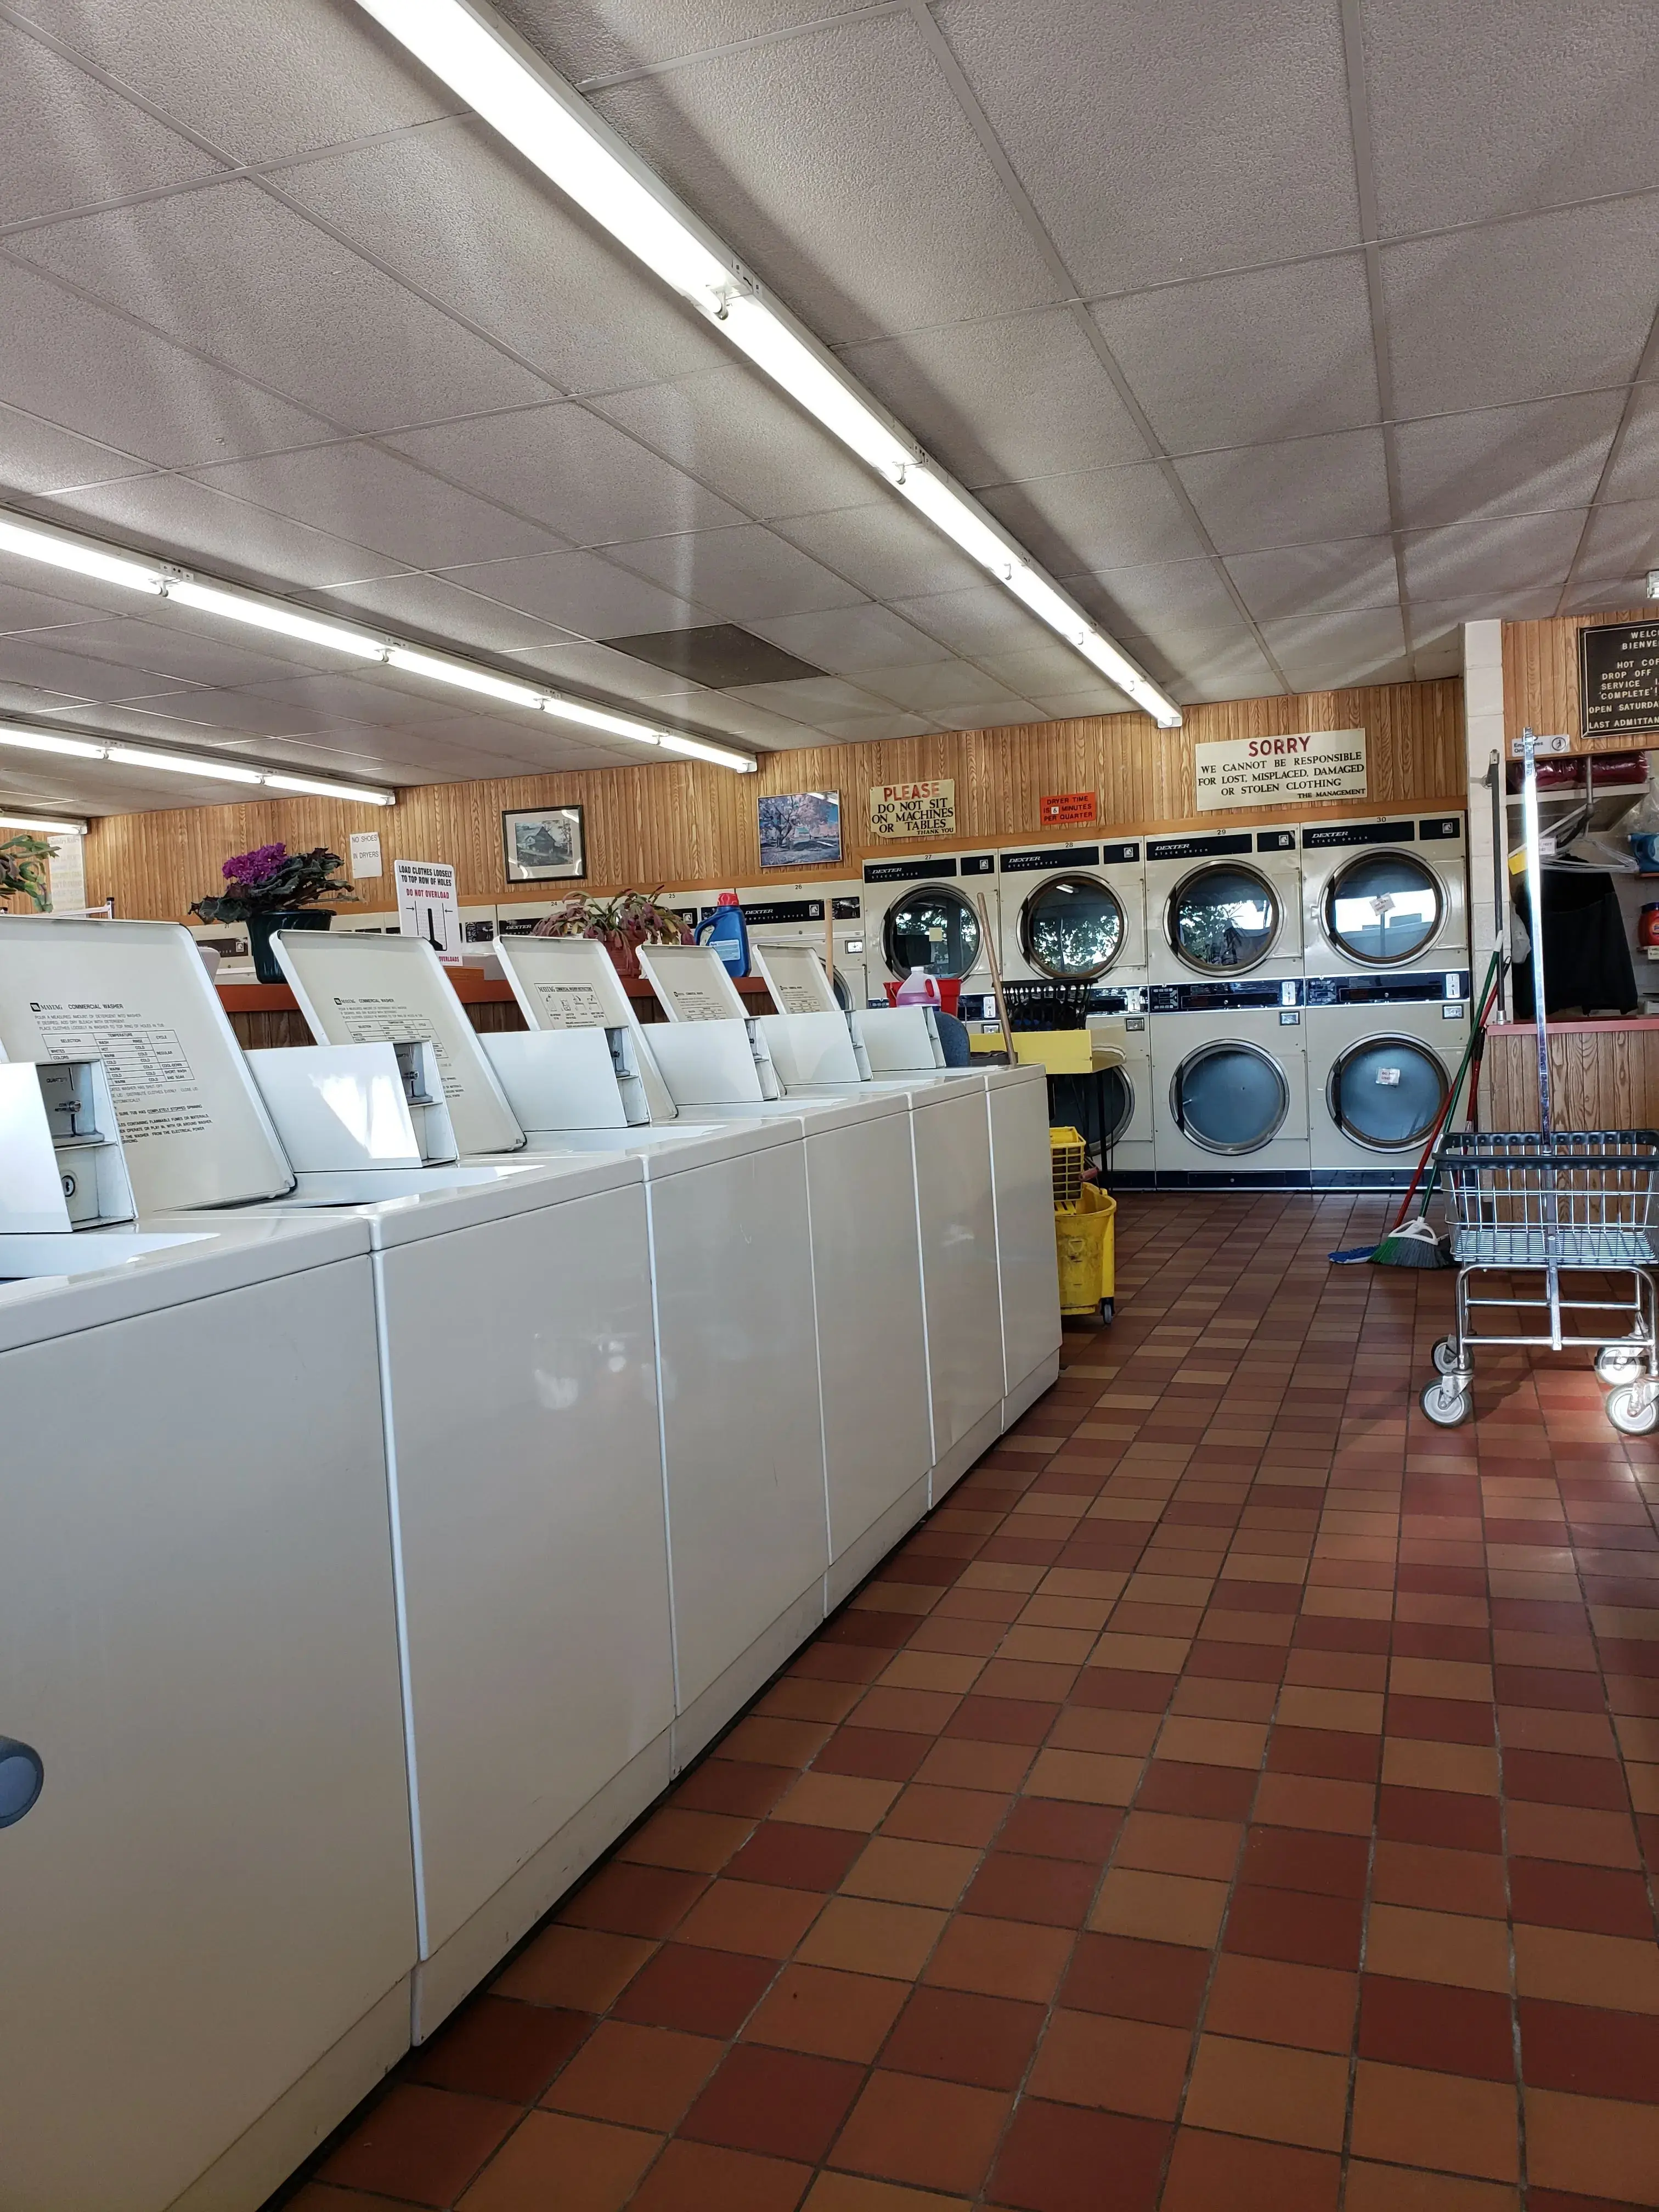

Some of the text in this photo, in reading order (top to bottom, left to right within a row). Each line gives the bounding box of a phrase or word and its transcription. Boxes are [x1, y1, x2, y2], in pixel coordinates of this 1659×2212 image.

[1631, 630, 1659, 639] WELC
[1622, 640, 1659, 650] BIENVE
[1602, 669, 1652, 680] DROP OFF
[1601, 680, 1640, 690] SERVICE
[1589, 701, 1659, 714] OPEN SATURDA
[1589, 721, 1610, 729] LAST
[1248, 736, 1311, 757] SORRY
[1201, 752, 1362, 774] WE CANNOT BE RESPONSIBLE
[1198, 777, 1216, 786] FOR
[1221, 774, 1248, 785] LOST,
[1314, 764, 1364, 776] DAMAGED
[884, 782, 940, 802] PLEASE
[1241, 783, 1279, 794] STOLEN
[1286, 778, 1341, 791] CLOTHING
[1316, 788, 1366, 798] MANAGEMENT
[878, 798, 947, 814] DO NOT SIT
[872, 807, 953, 824] ON MACHINES
[879, 819, 946, 833] OR TABLES
[399, 865, 452, 878] LOAD CLOTHES LOOSELY
[437, 878, 452, 887] HOLES
[425, 890, 449, 899] OVERLOAD
